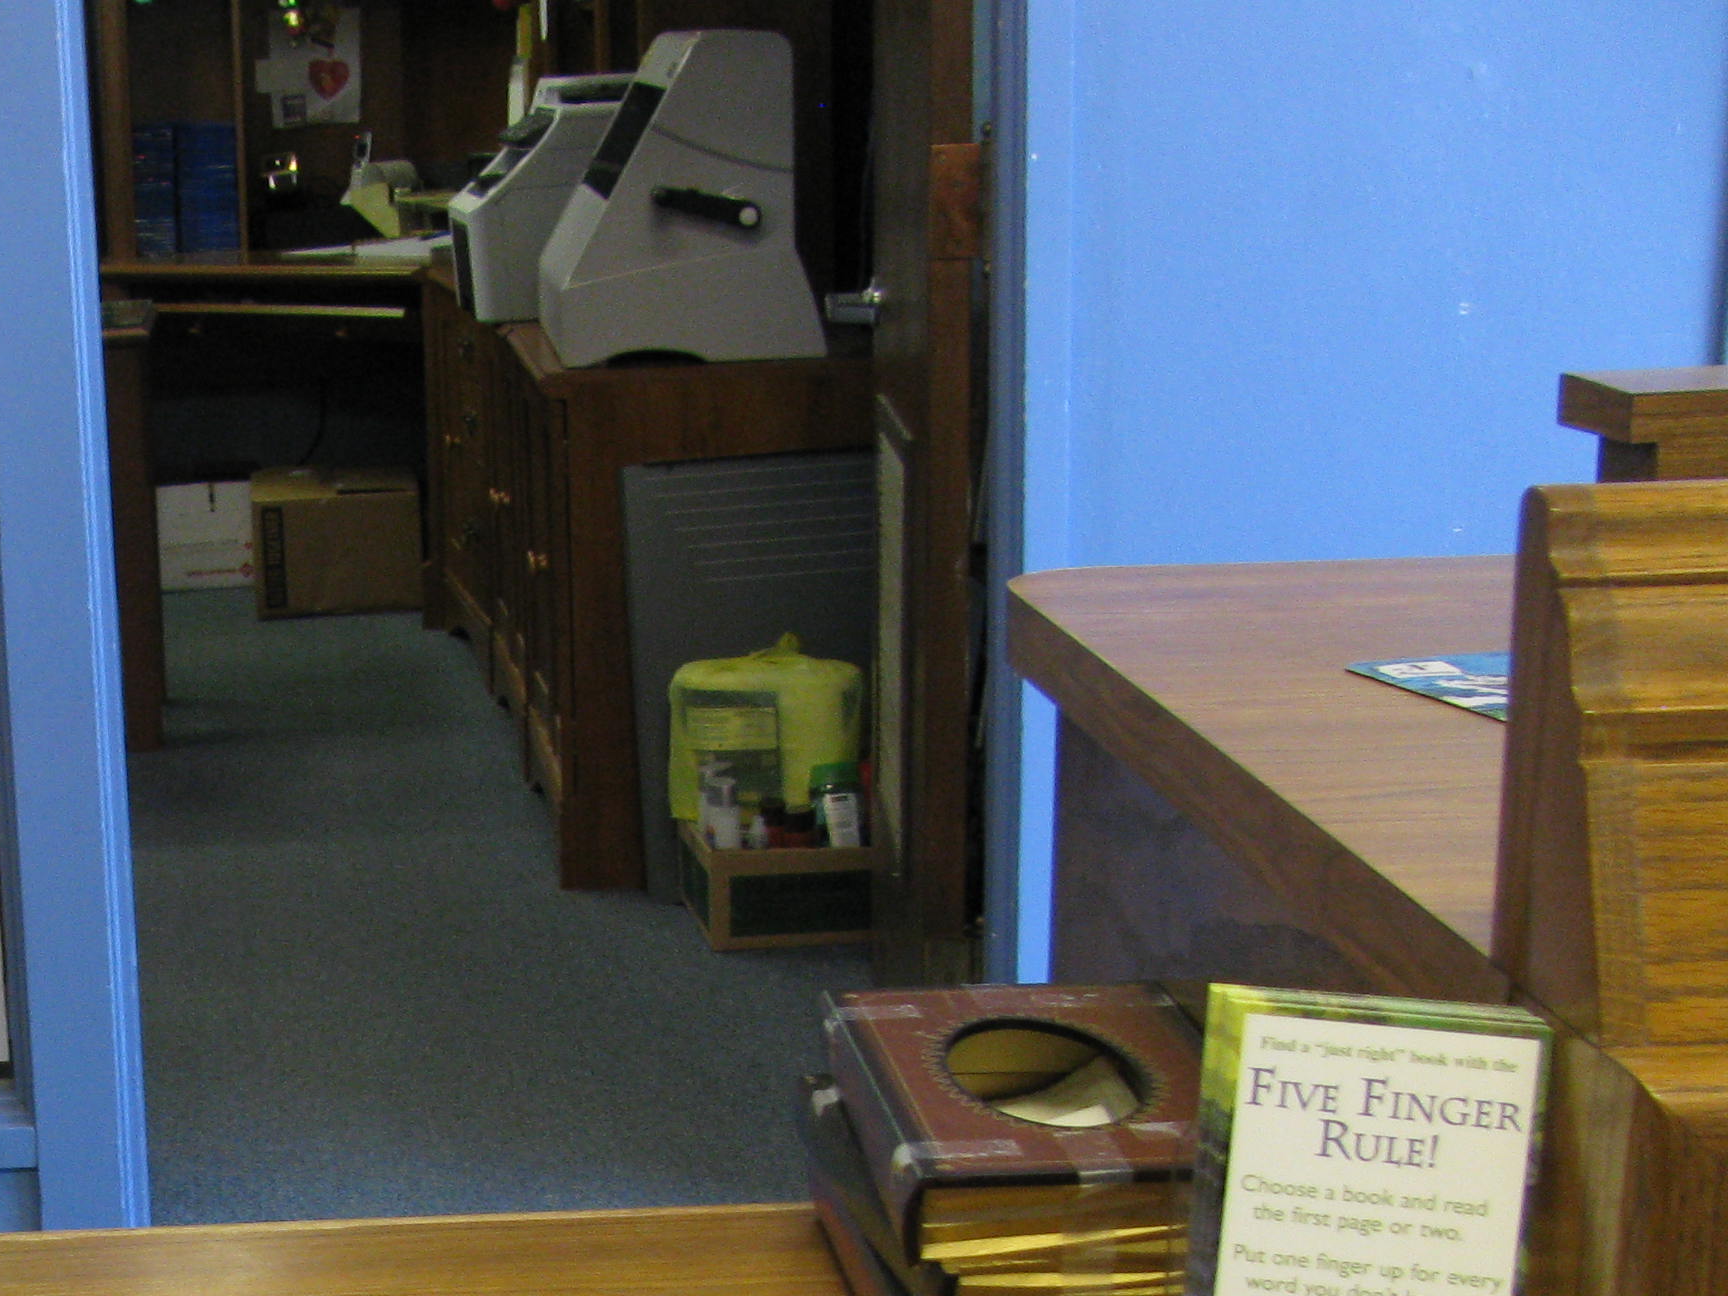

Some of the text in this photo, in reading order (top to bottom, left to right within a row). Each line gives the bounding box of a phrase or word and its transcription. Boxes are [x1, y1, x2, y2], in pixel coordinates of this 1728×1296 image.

[1245, 1066, 1523, 1133] FIVE FINGER
[1313, 1118, 1440, 1169] RULE!
[1241, 1173, 1490, 1217] Choose a book and read
[1253, 1204, 1287, 1222] the
[1292, 1207, 1332, 1227] first
[1337, 1216, 1383, 1236] page
[1388, 1222, 1414, 1235] or
